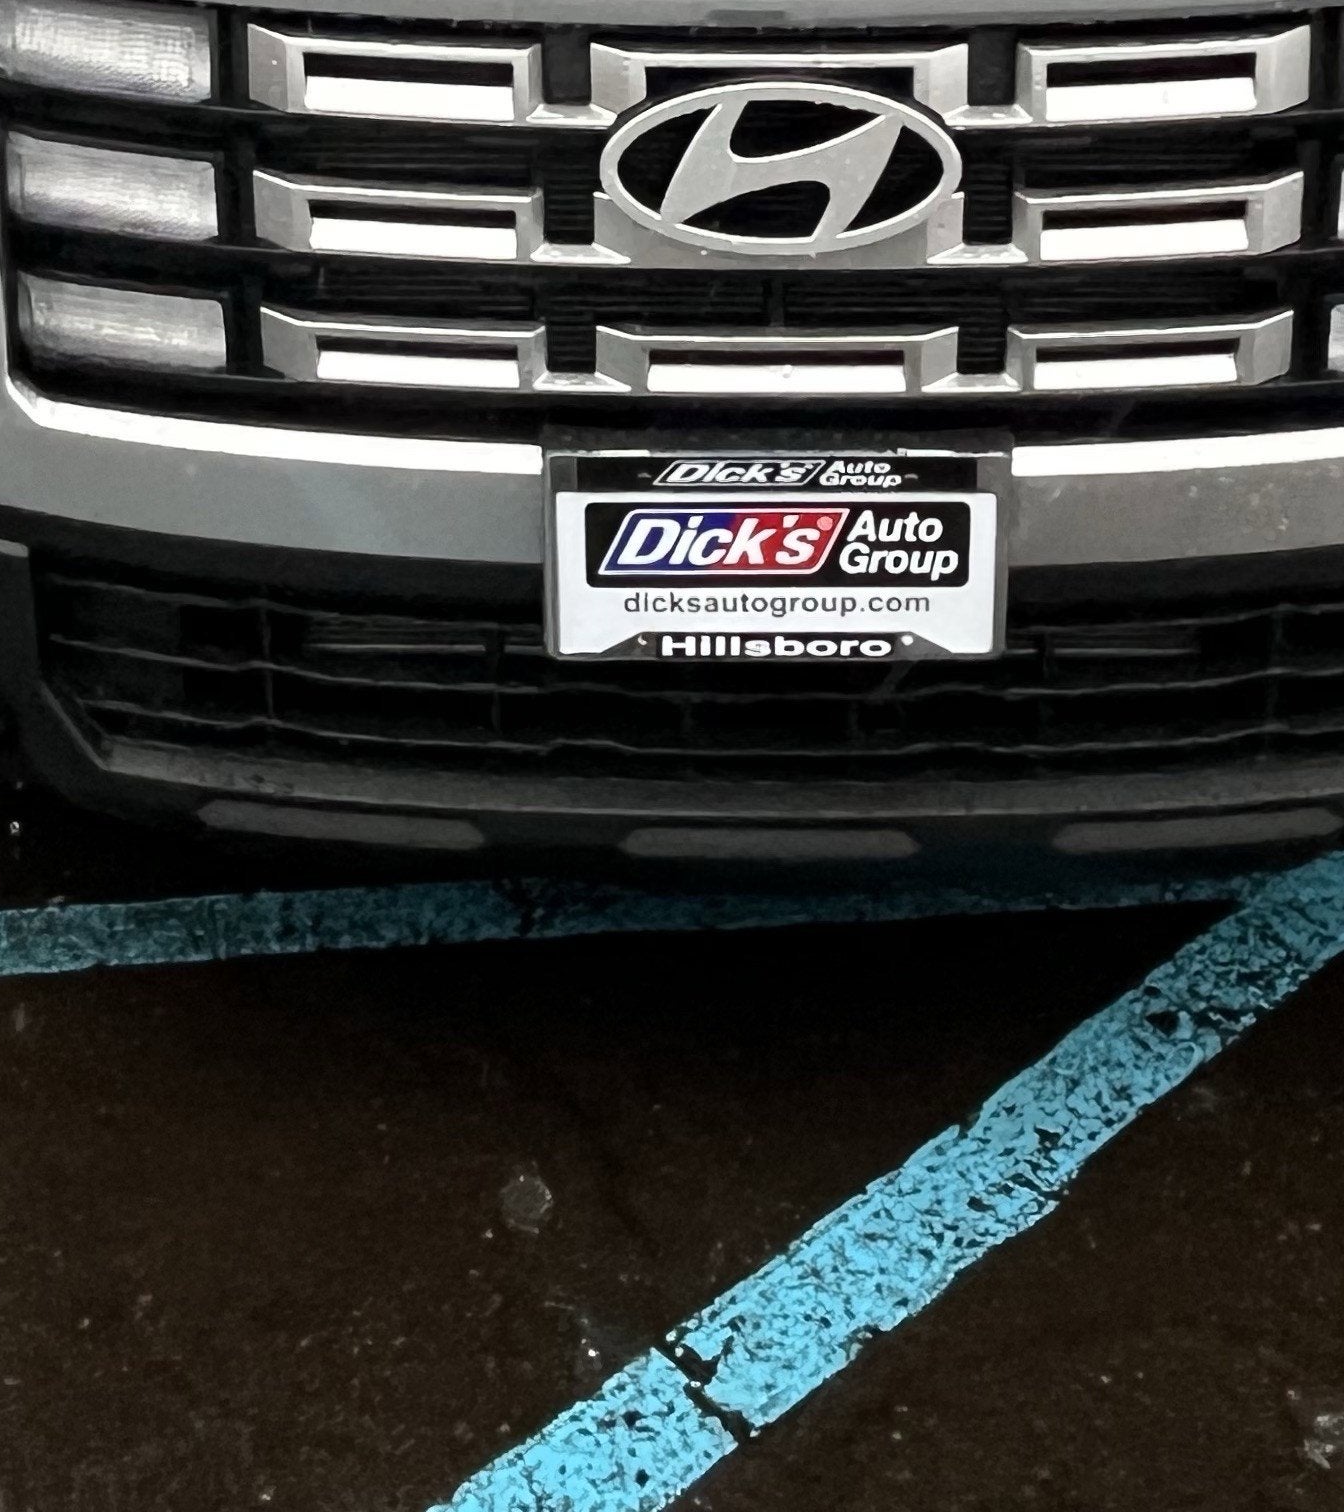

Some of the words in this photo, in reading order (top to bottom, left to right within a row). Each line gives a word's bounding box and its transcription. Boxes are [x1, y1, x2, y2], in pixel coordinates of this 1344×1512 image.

[826, 461, 890, 474] Auto
[819, 473, 901, 487] Group
[846, 510, 943, 543] Auto
[616, 515, 821, 566] Dick's
[839, 546, 958, 580] Group
[624, 593, 930, 617] dicksautogroup.com
[661, 635, 891, 657] Hillsboro
